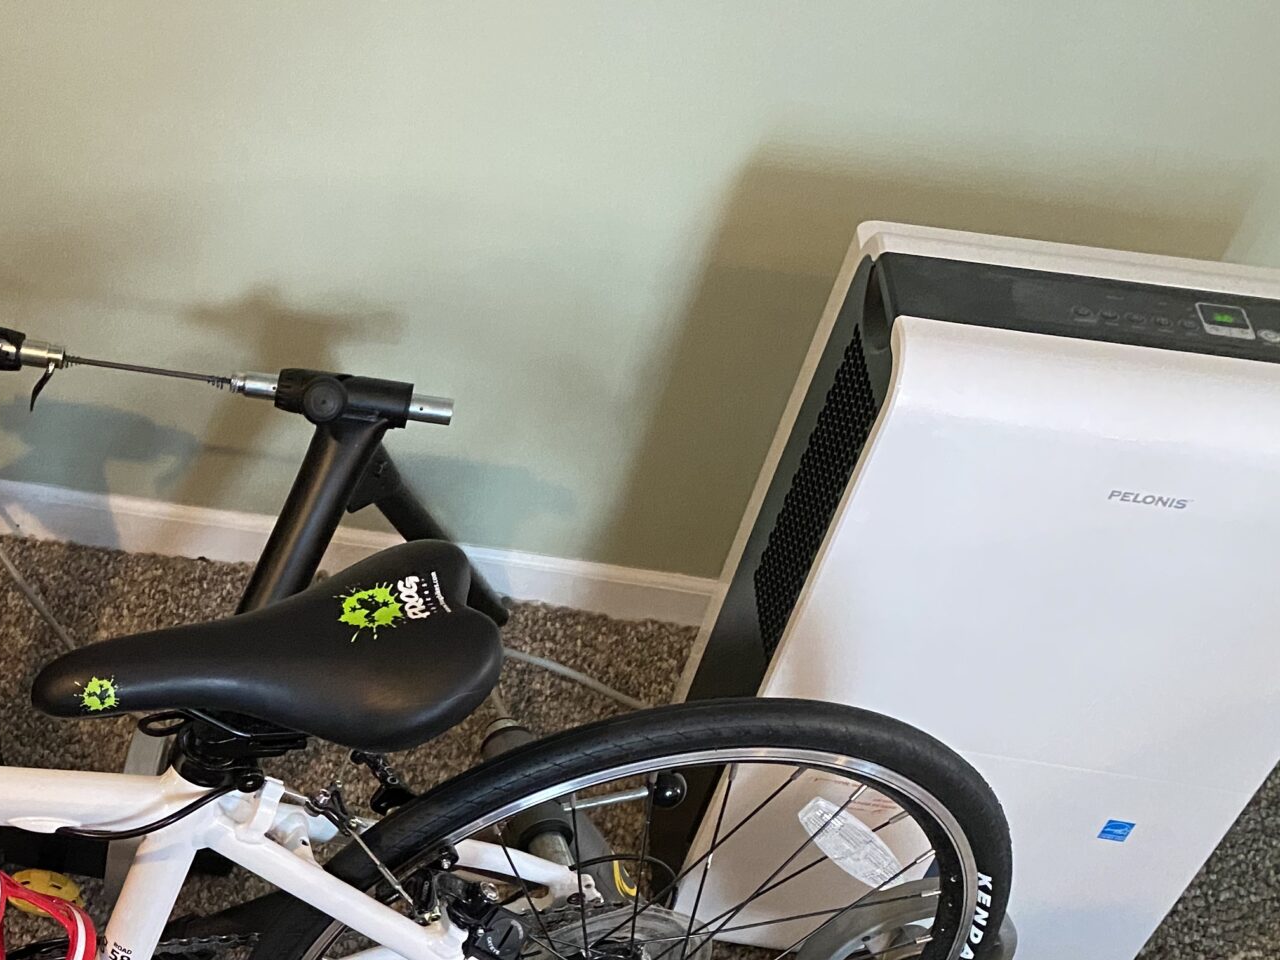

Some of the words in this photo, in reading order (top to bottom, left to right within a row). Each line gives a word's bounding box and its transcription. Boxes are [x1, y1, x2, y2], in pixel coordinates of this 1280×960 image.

[1107, 489, 1189, 510] PELONIS
[397, 575, 431, 620] FROG
[959, 871, 993, 960] KENDA
[113, 942, 133, 955] ROAD
